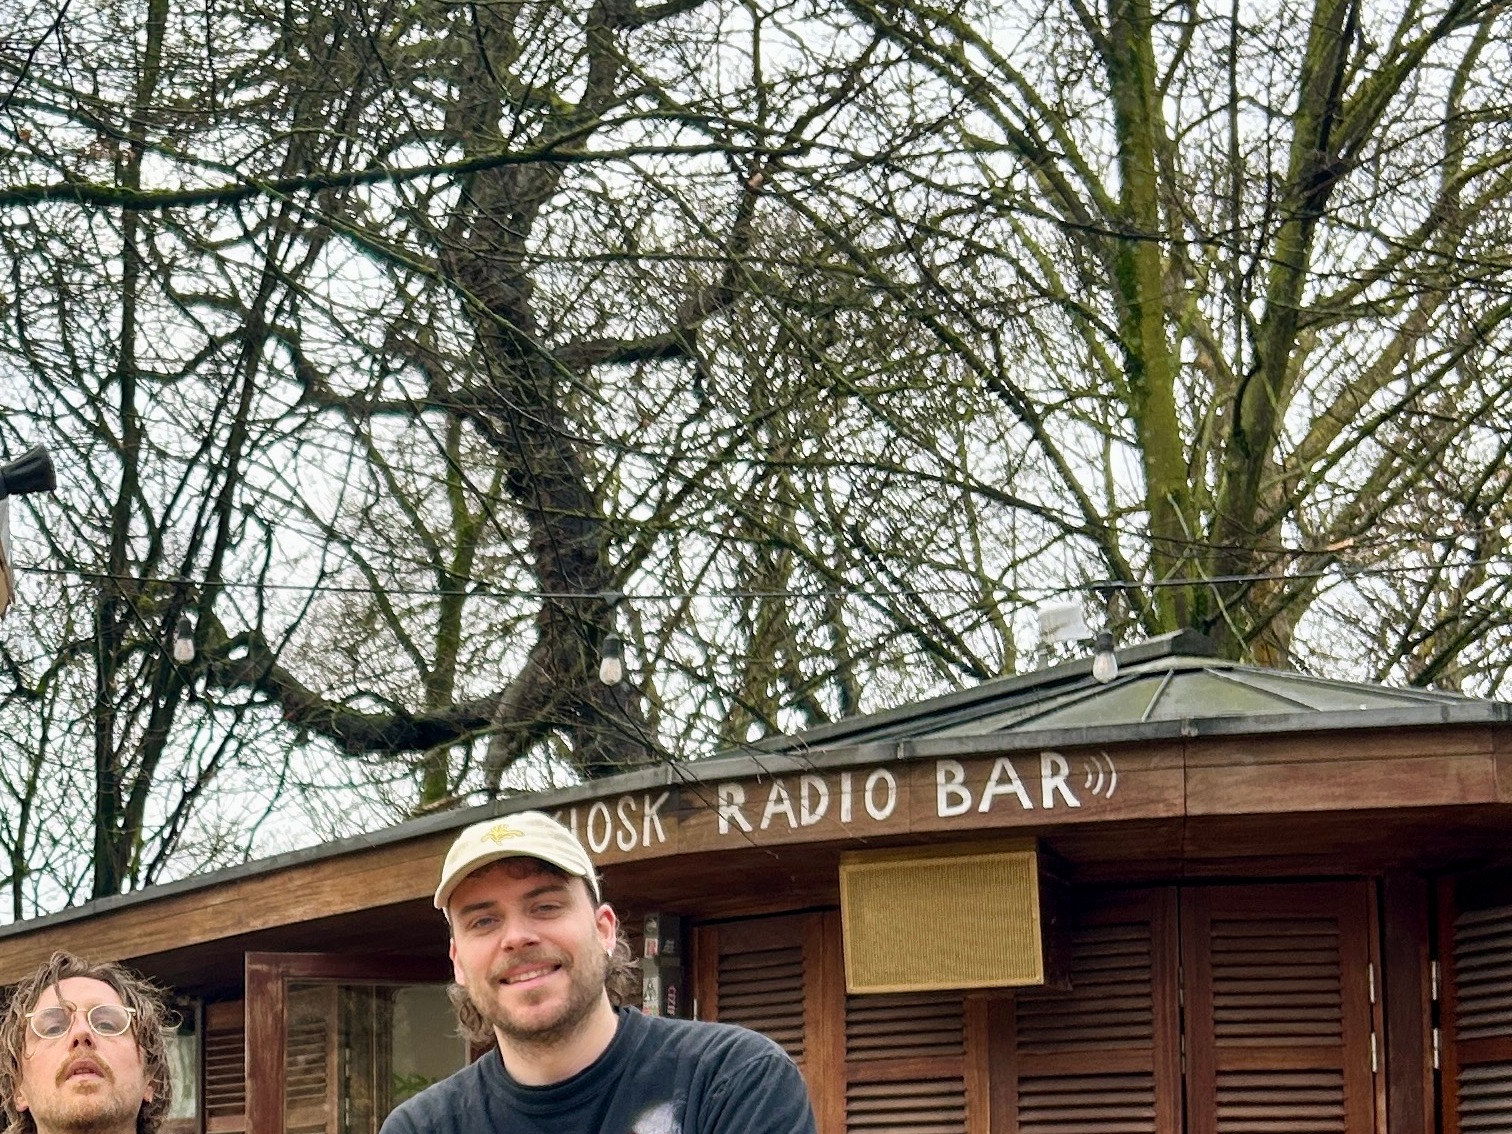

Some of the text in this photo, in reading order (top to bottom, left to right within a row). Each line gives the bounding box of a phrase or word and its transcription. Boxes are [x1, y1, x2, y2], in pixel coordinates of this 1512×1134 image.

[554, 751, 1081, 854] IOSK RADIO BAR
